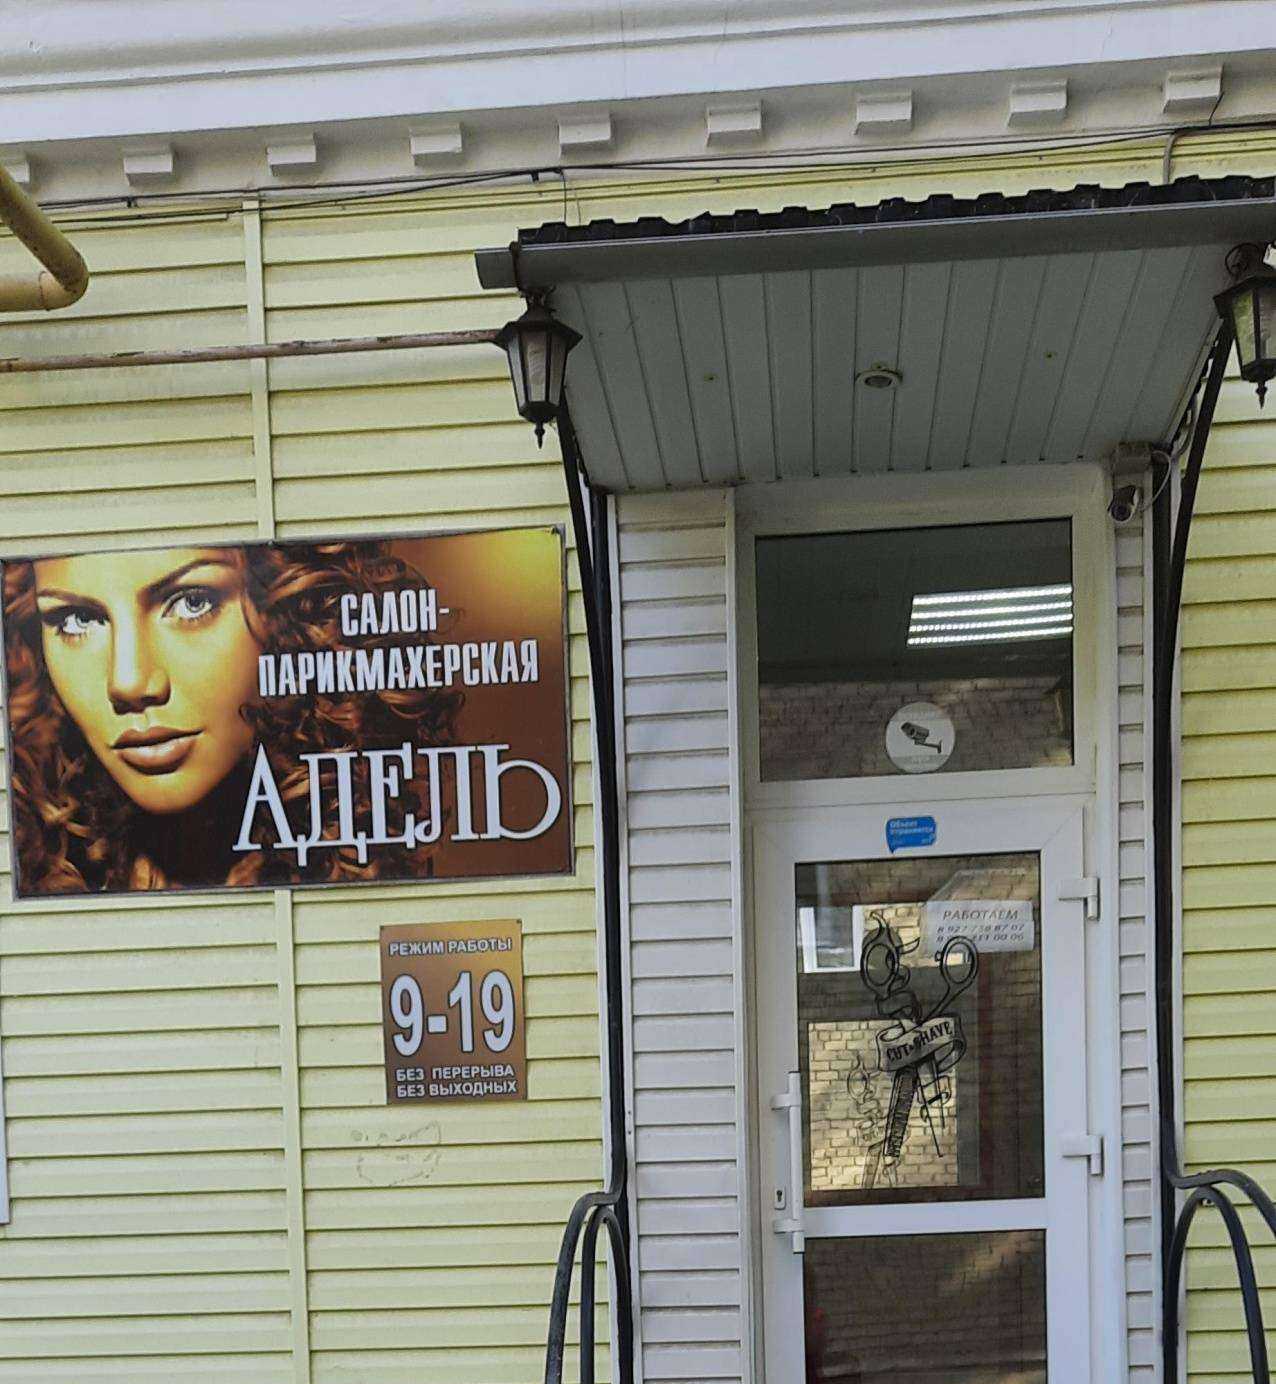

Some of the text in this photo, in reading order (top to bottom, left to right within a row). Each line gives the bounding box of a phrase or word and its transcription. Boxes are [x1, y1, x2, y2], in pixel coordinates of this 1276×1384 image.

[340, 588, 450, 637] САЛОН-
[258, 639, 539, 697] ПАРИКМАХЕРСКАЯ
[232, 741, 562, 867] АДЕЛЬ
[943, 909, 1019, 921] РАБОТАЕМ
[389, 938, 512, 956] РЕЖИМ РАБОТЫ
[390, 969, 516, 1057] 9-19
[396, 1064, 515, 1082] БЕЗ ПЕРЕРЫВА
[397, 1080, 517, 1098] БЕЗ ВЫХОДНЫХ
